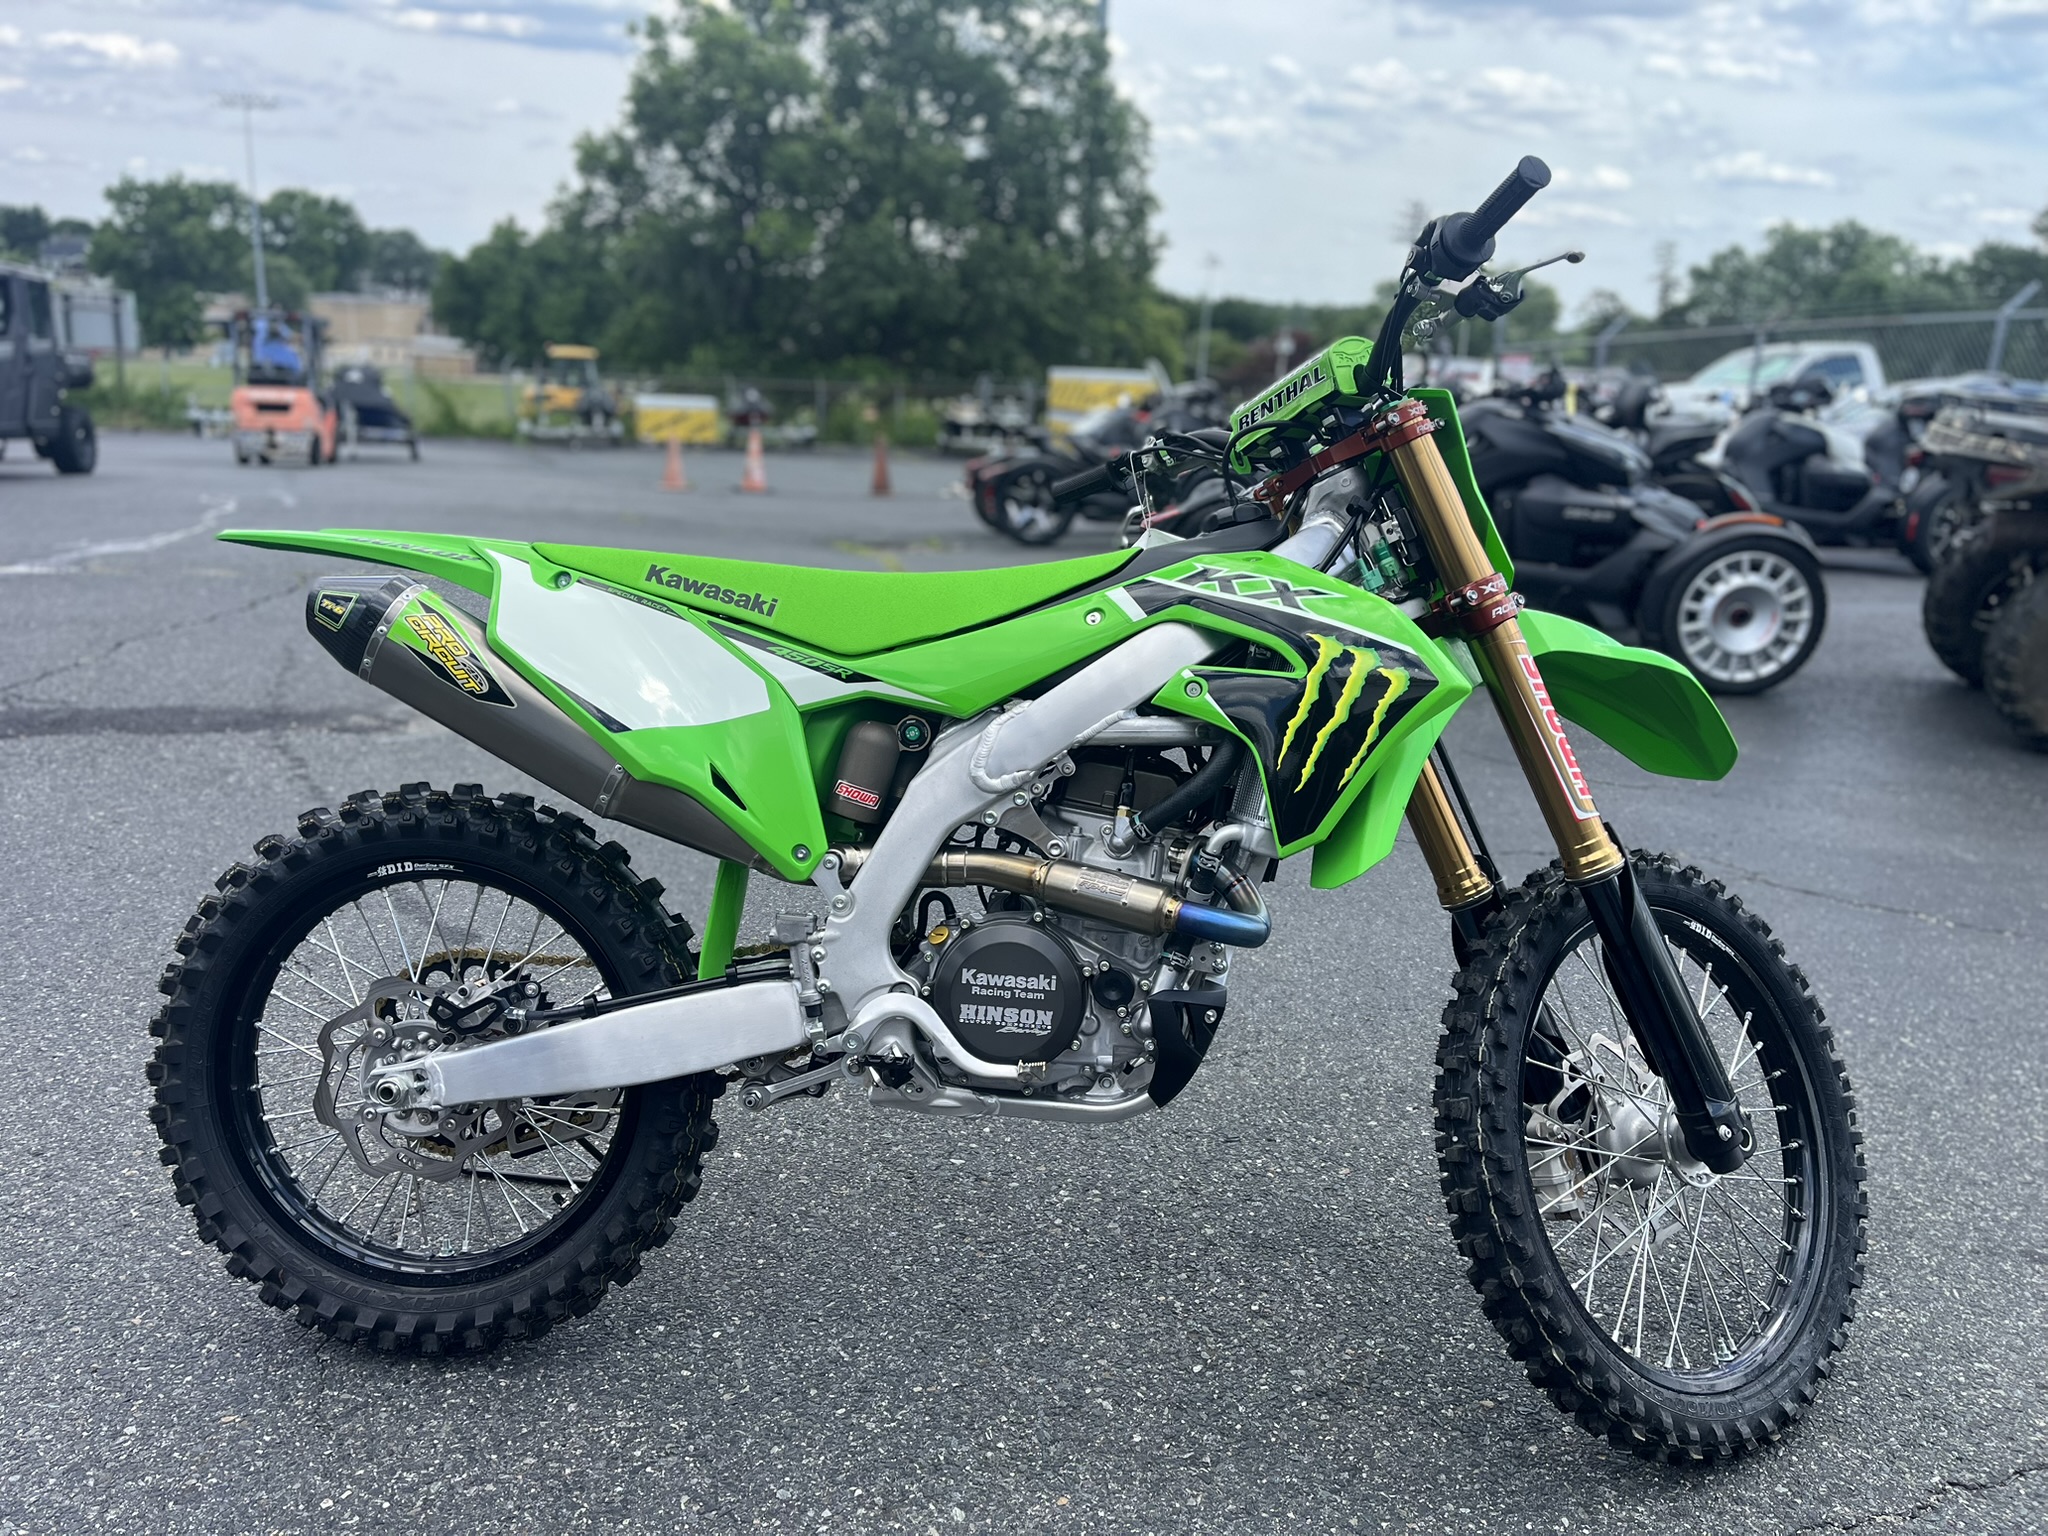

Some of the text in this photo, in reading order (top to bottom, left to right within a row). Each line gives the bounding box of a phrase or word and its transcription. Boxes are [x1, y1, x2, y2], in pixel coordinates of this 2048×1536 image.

[1237, 365, 1326, 432] RENTHAL
[606, 587, 668, 612] SPECIAL RACER
[644, 563, 779, 618] Kawasaki
[422, 613, 470, 658] PRO
[404, 614, 485, 694] CIRCUIT
[766, 645, 854, 680] 450SR
[835, 783, 880, 807] SHOWA
[961, 967, 1057, 991] Kawasaki
[971, 985, 1045, 1000] Racing Team
[959, 1003, 1054, 1026] HINSON
